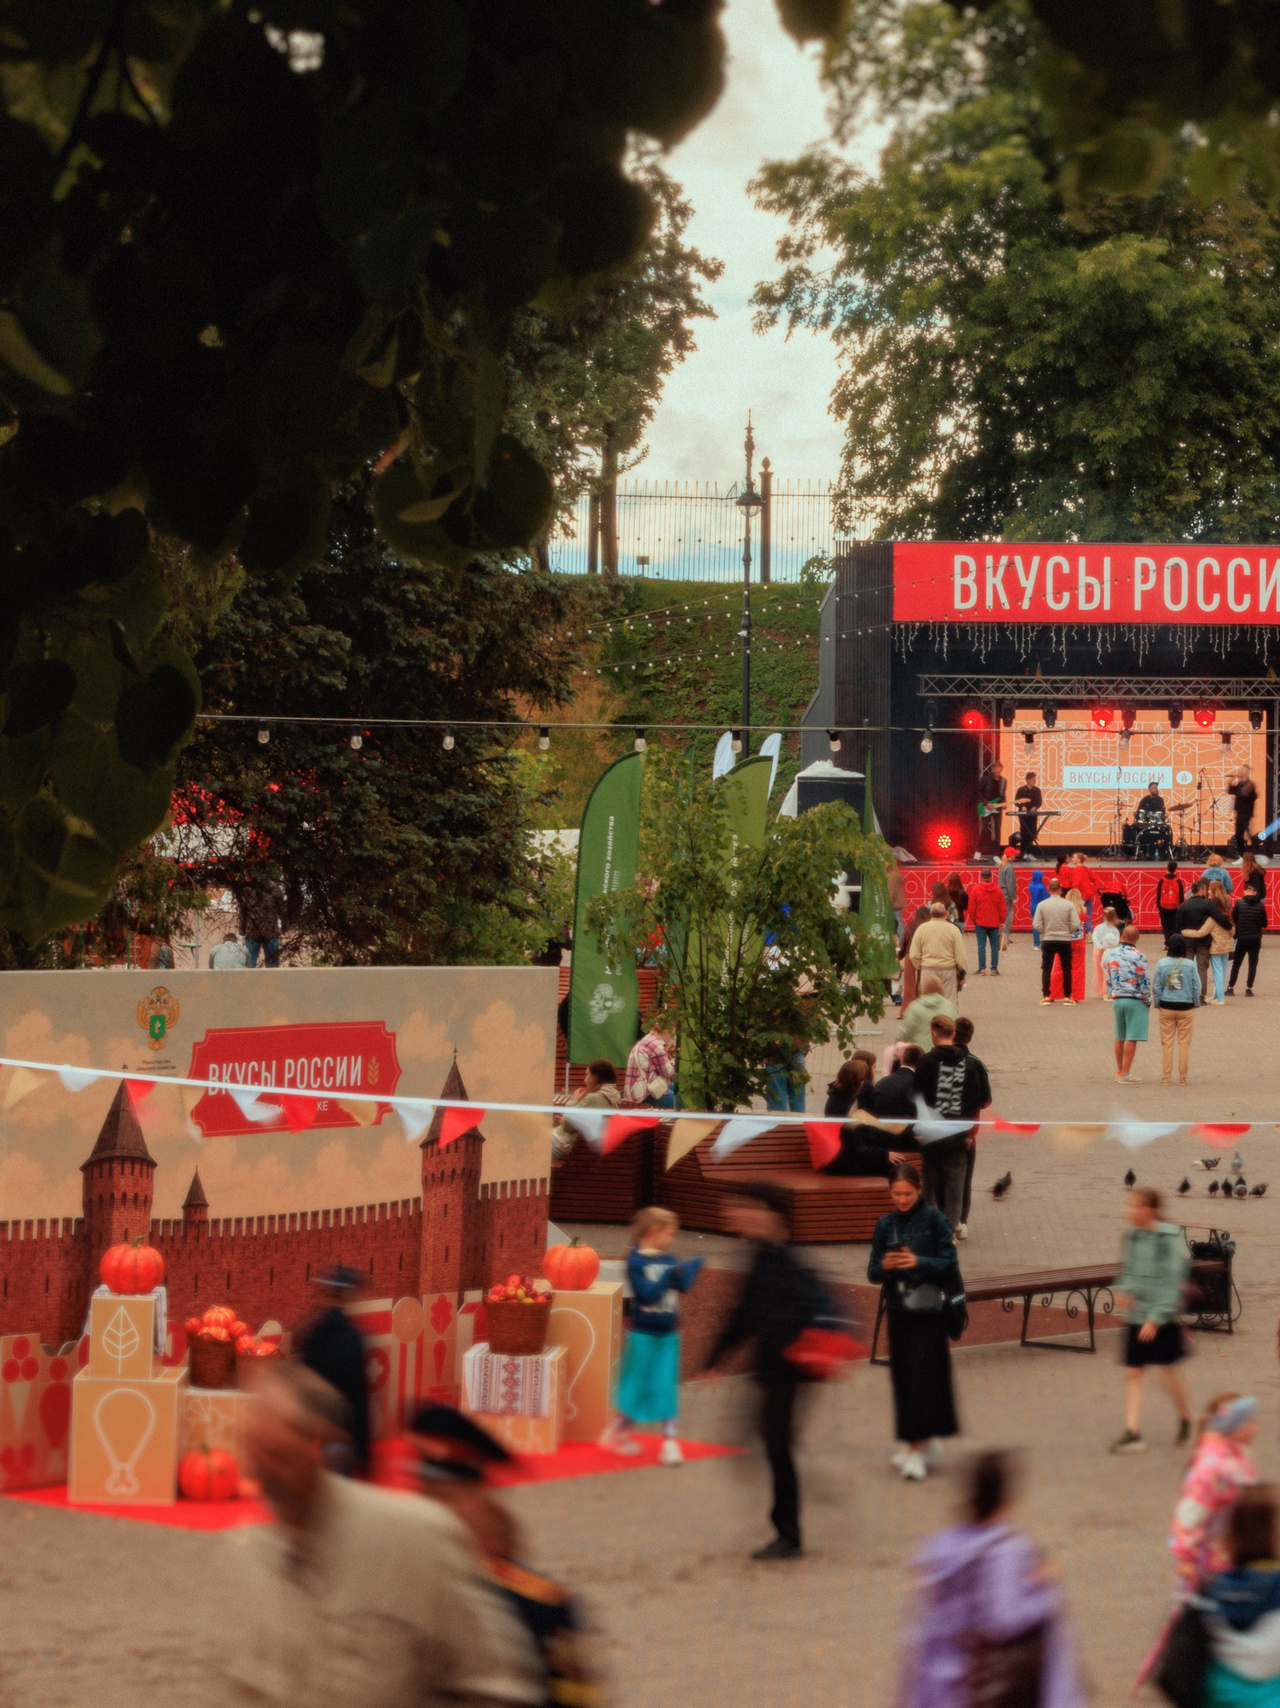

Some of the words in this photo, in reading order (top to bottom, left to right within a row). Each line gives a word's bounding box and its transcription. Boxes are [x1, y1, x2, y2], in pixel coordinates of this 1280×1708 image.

[953, 554, 1111, 611] ВКУСЫ
[1069, 771, 1111, 784] ВКУСЫ
[1116, 771, 1165, 784] РОССИИ
[208, 1060, 276, 1097] ВКУСЫ
[284, 1055, 362, 1090] РОССИИ
